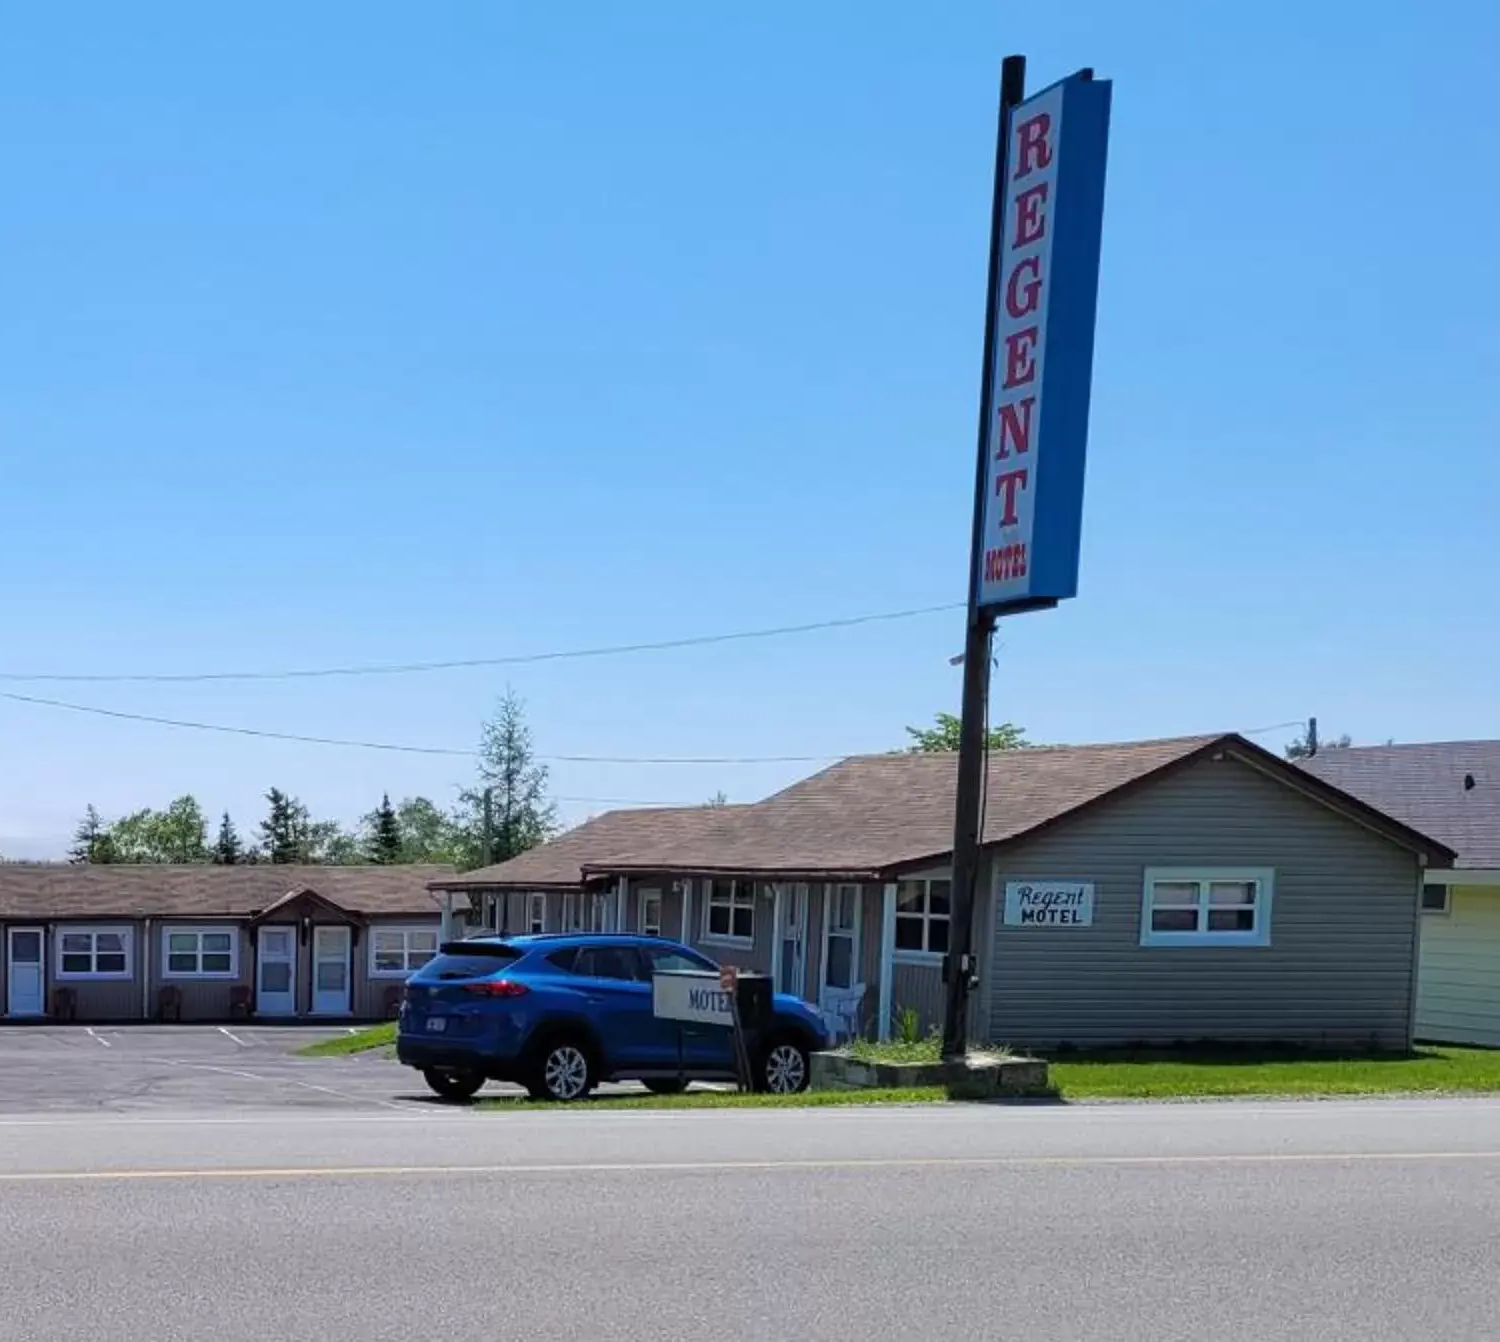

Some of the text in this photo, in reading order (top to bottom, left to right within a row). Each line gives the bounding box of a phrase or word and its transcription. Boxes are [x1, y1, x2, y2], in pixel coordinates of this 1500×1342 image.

[995, 112, 1053, 529] REGENT
[985, 543, 1026, 581] MOTEL
[1017, 886, 1084, 910] Regent
[1021, 909, 1082, 923] MOTEL
